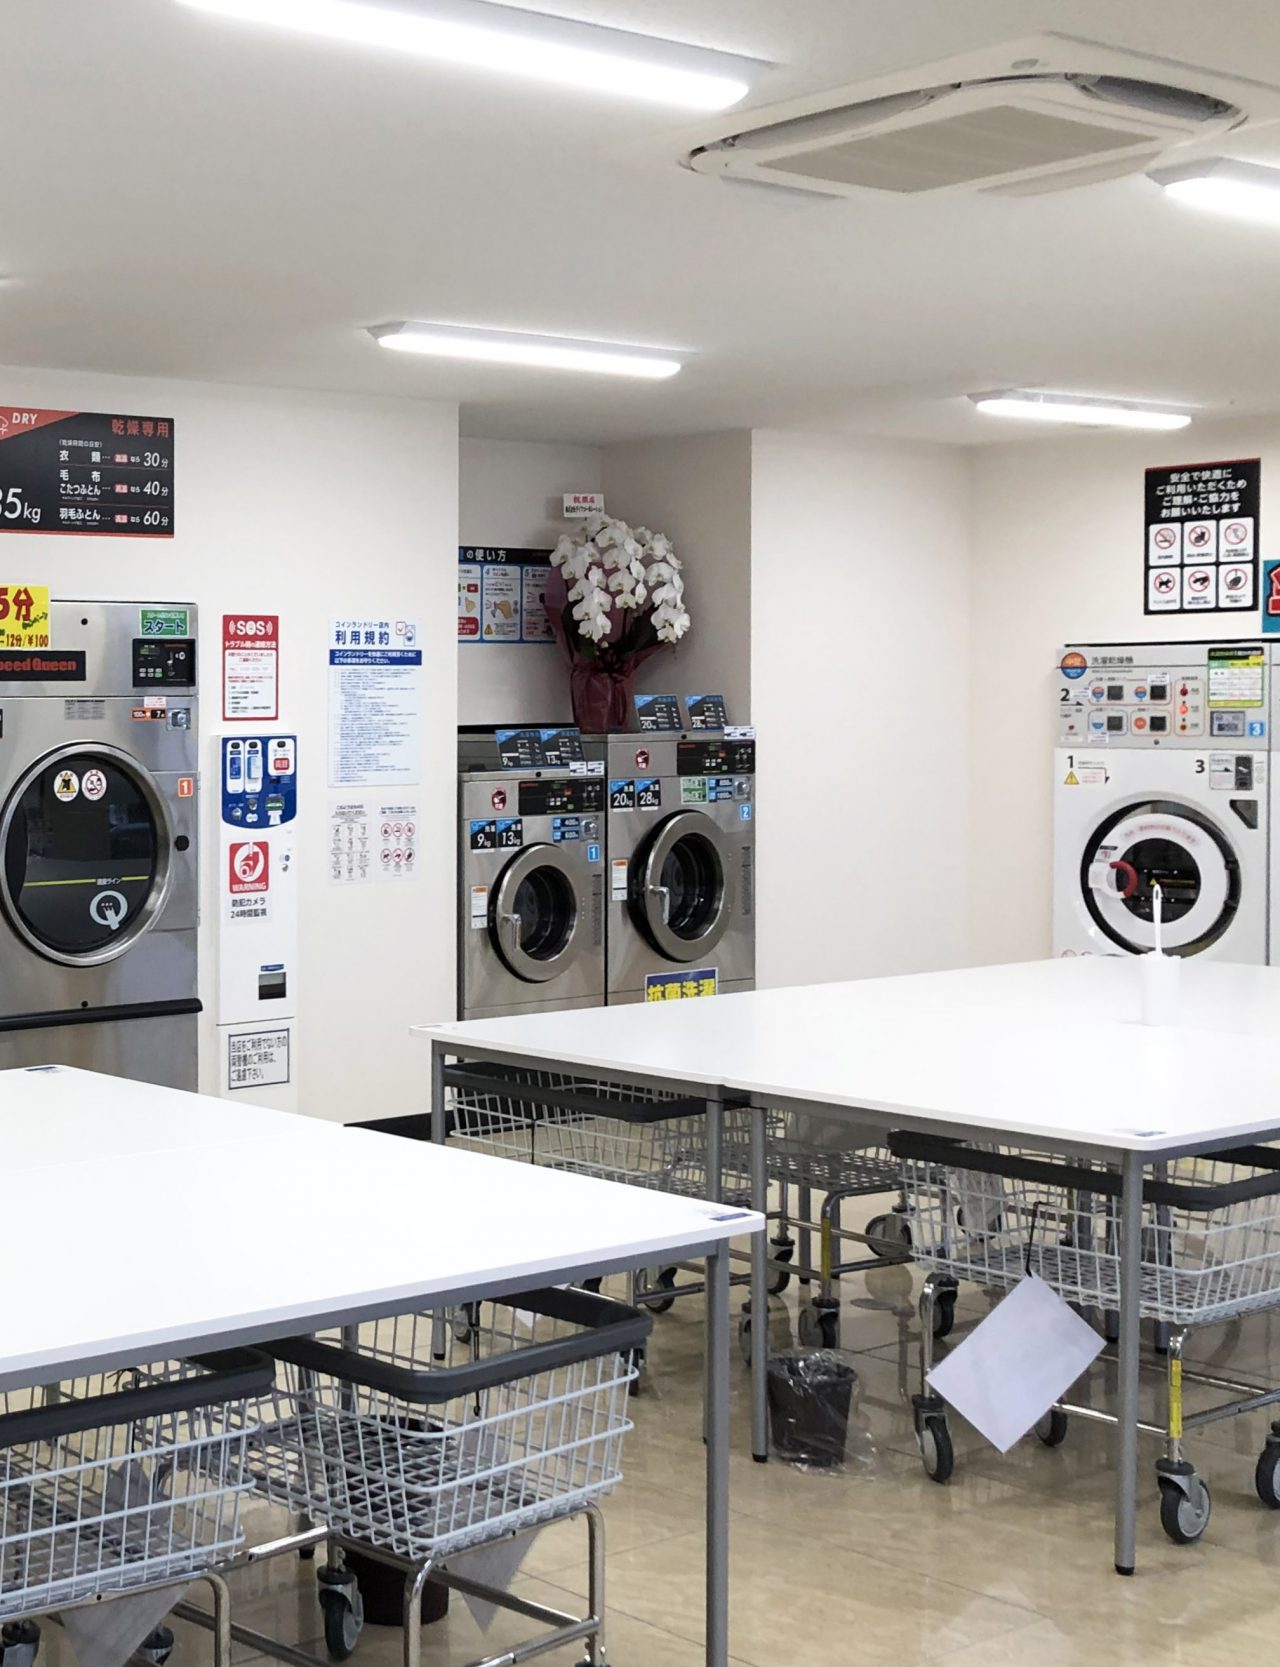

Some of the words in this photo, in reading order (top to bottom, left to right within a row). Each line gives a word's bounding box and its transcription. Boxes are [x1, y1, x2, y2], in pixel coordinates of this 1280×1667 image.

[12, 413, 37, 424] DRY
[60, 484, 100, 495] こたつふとん
[60, 508, 100, 520] 羽毛ふとん
[144, 621, 184, 633] スタート
[237, 620, 265, 635] SOS
[335, 630, 390, 645] 利用規約
[33, 659, 76, 671] Queen
[1060, 689, 1070, 701] 2
[1253, 723, 1261, 735] 3
[1067, 756, 1074, 768] 1
[1195, 760, 1205, 773] 3
[182, 781, 189, 794] 1
[742, 806, 749, 818] 2
[590, 846, 596, 857] 1
[231, 897, 266, 908] 防犯カメラ
